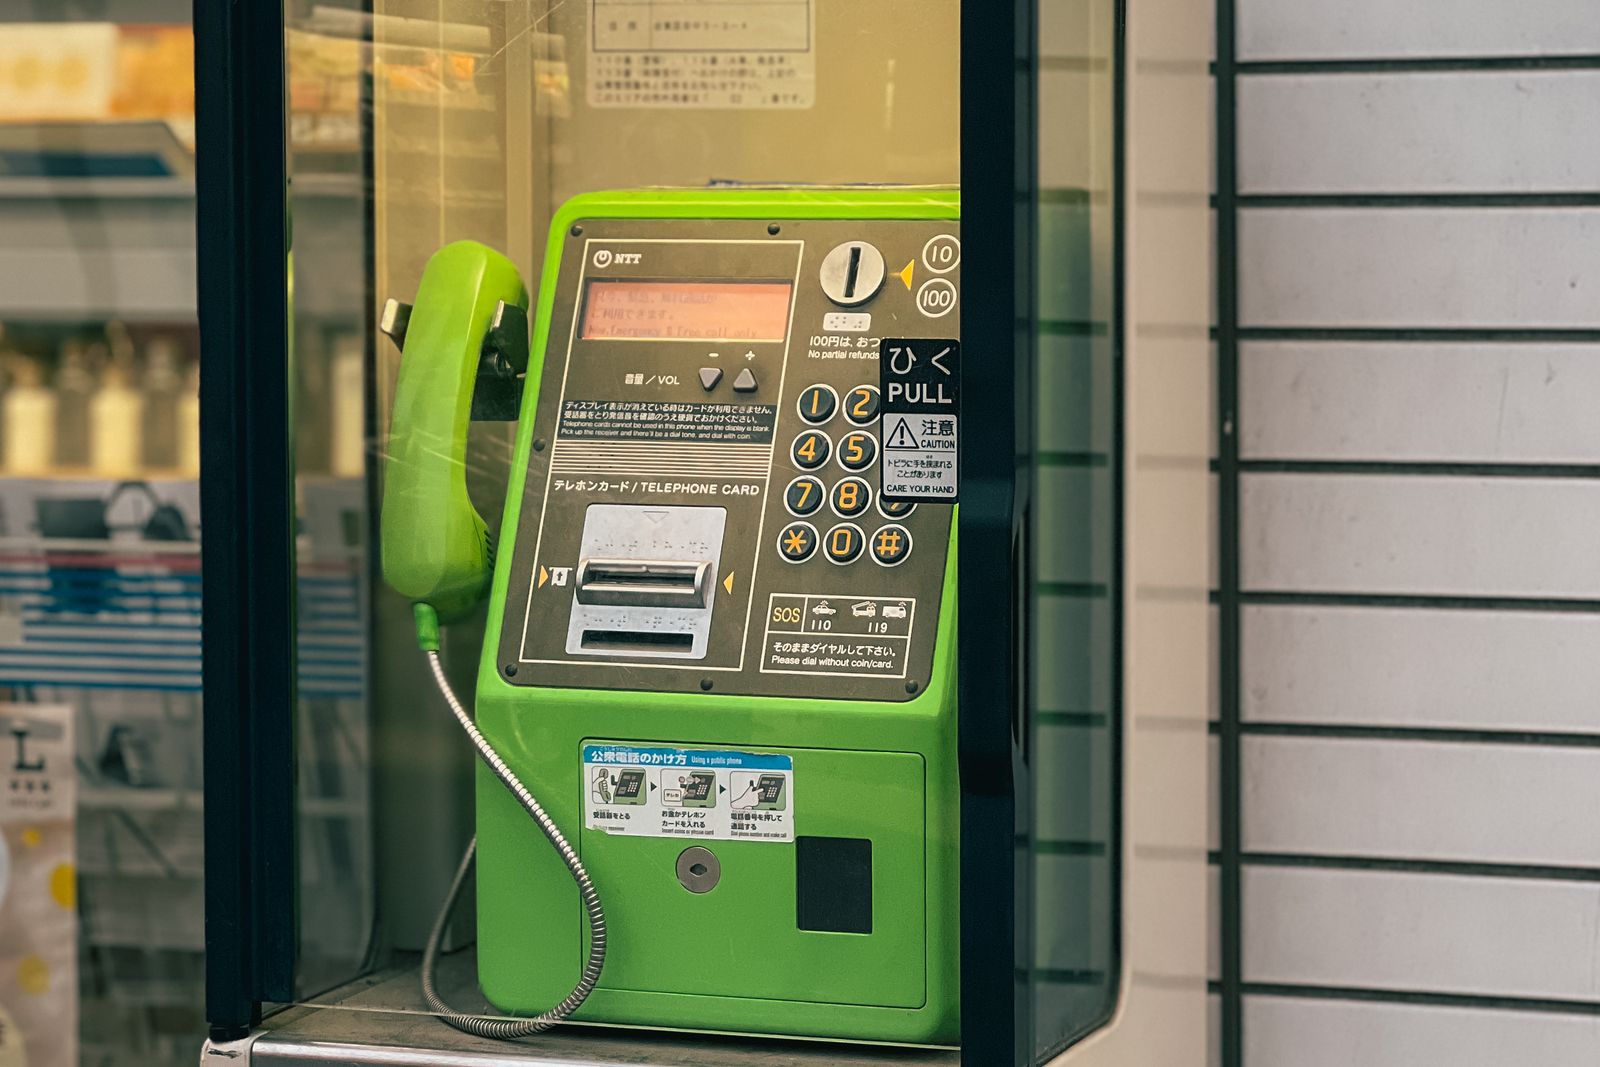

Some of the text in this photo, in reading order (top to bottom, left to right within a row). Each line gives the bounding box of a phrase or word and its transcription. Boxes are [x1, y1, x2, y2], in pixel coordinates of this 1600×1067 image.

[614, 253, 641, 264] NTT
[932, 246, 952, 262] 10
[923, 290, 950, 307] 100
[809, 335, 881, 348] 100円は、おつ
[808, 350, 820, 358] No
[821, 350, 847, 360] partial
[889, 346, 951, 375] ひく
[624, 373, 644, 385] 音量
[658, 375, 680, 385] VOL
[888, 382, 952, 404] PULL
[811, 389, 871, 416] 1 2
[563, 420, 593, 429] Telephone
[725, 424, 746, 432] display
[921, 420, 954, 436] 注意
[797, 435, 865, 461] 4 5
[920, 439, 956, 449] CAUTION
[897, 470, 943, 479] ことがあります
[554, 479, 630, 493] テレホンカード
[640, 482, 717, 495] TELEPHONE
[722, 484, 760, 496] CARD
[886, 484, 954, 494] CARE YOUR HAND
[796, 482, 857, 509] 7 8
[831, 529, 852, 555] 0
[772, 607, 801, 623] SOS
[811, 619, 832, 631] 110
[868, 622, 888, 633] 119
[773, 642, 896, 657] そのままダイヤルして下さい。
[771, 655, 894, 668] Please dial without coin/card.
[591, 751, 687, 765] 公衆電話のかけ方
[691, 756, 705, 765] Using
[711, 757, 726, 765] public
[727, 757, 742, 765] phone
[661, 810, 706, 818] お金かテレホン
[731, 813, 782, 821] 電話番号を押して
[661, 820, 706, 828] カードを入れる
[731, 822, 757, 830] 通話する
